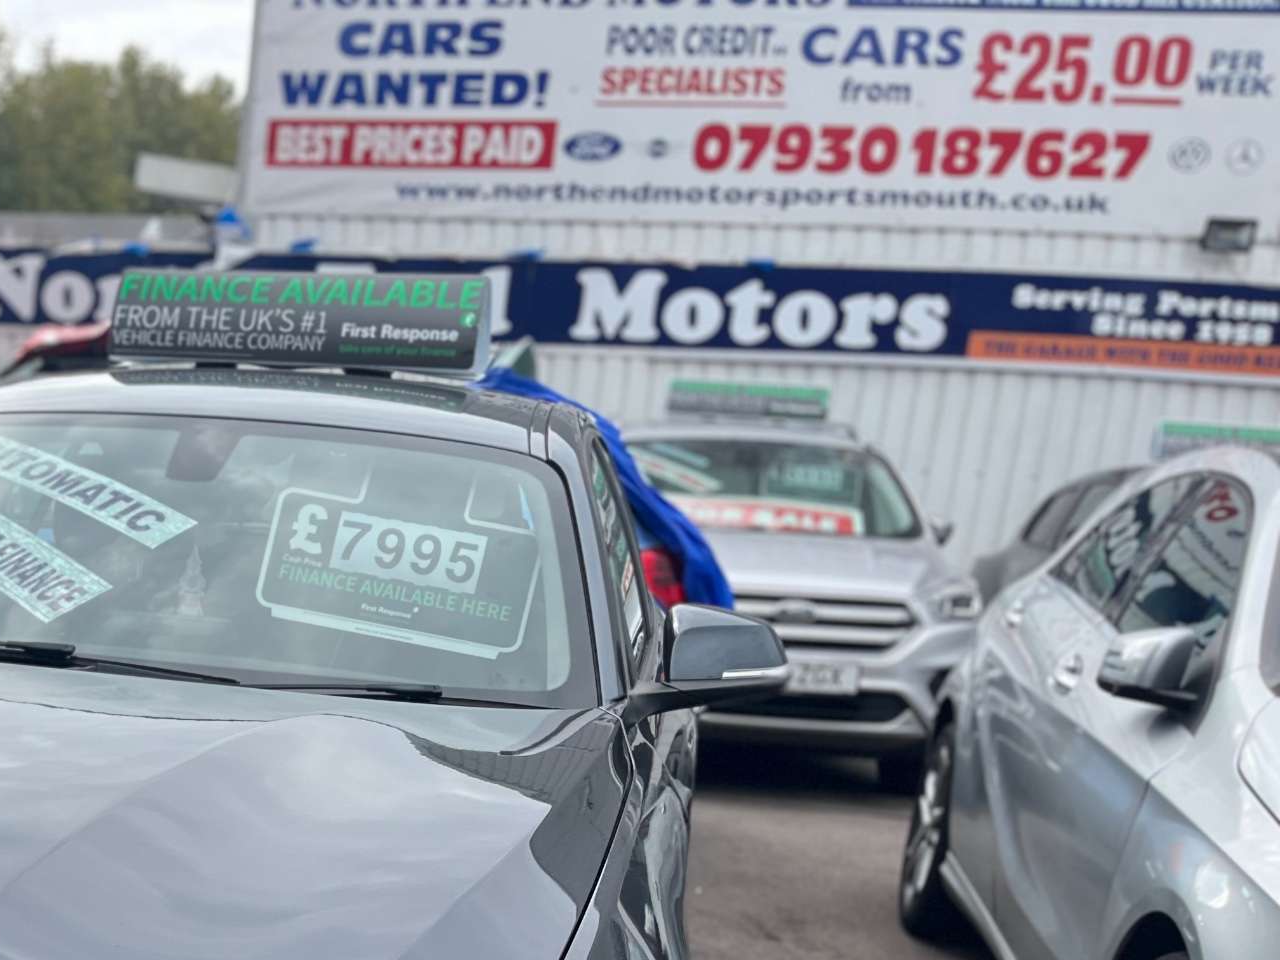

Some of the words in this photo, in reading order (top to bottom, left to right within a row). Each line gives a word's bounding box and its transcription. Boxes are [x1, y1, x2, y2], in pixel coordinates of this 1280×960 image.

[339, 20, 504, 57] CARS
[605, 24, 676, 56] POOR
[682, 24, 776, 57] CREDIT
[801, 25, 966, 67] CARS
[972, 31, 1194, 106] £25.00
[1208, 48, 1266, 71] PER
[280, 69, 551, 109] WANTED!
[599, 65, 786, 98] SPECIALISTS
[839, 76, 913, 104] from
[1195, 73, 1273, 98] WEEK
[275, 124, 350, 164] BEST
[351, 125, 459, 165] PRICES
[462, 125, 547, 166] PAID
[692, 122, 902, 177] 07930
[908, 127, 1154, 182] 187627
[119, 274, 273, 304] FINANCE
[277, 276, 486, 311] AVAILABLE
[569, 267, 950, 350] Motors
[1012, 283, 1148, 319] Serving
[113, 304, 181, 330] FROM
[188, 306, 231, 331] THE
[239, 308, 296, 334] UK'S
[300, 311, 329, 334] #1
[340, 321, 377, 339] First
[379, 323, 460, 344] Response
[1091, 312, 1186, 341] Since
[112, 329, 175, 347] VEHICLE
[177, 330, 246, 350] FINANCE
[247, 332, 328, 352] COMPANY
[278, 563, 356, 593] FINANCE
[360, 580, 457, 612] AVAILABLE
[460, 594, 512, 622] HERE
